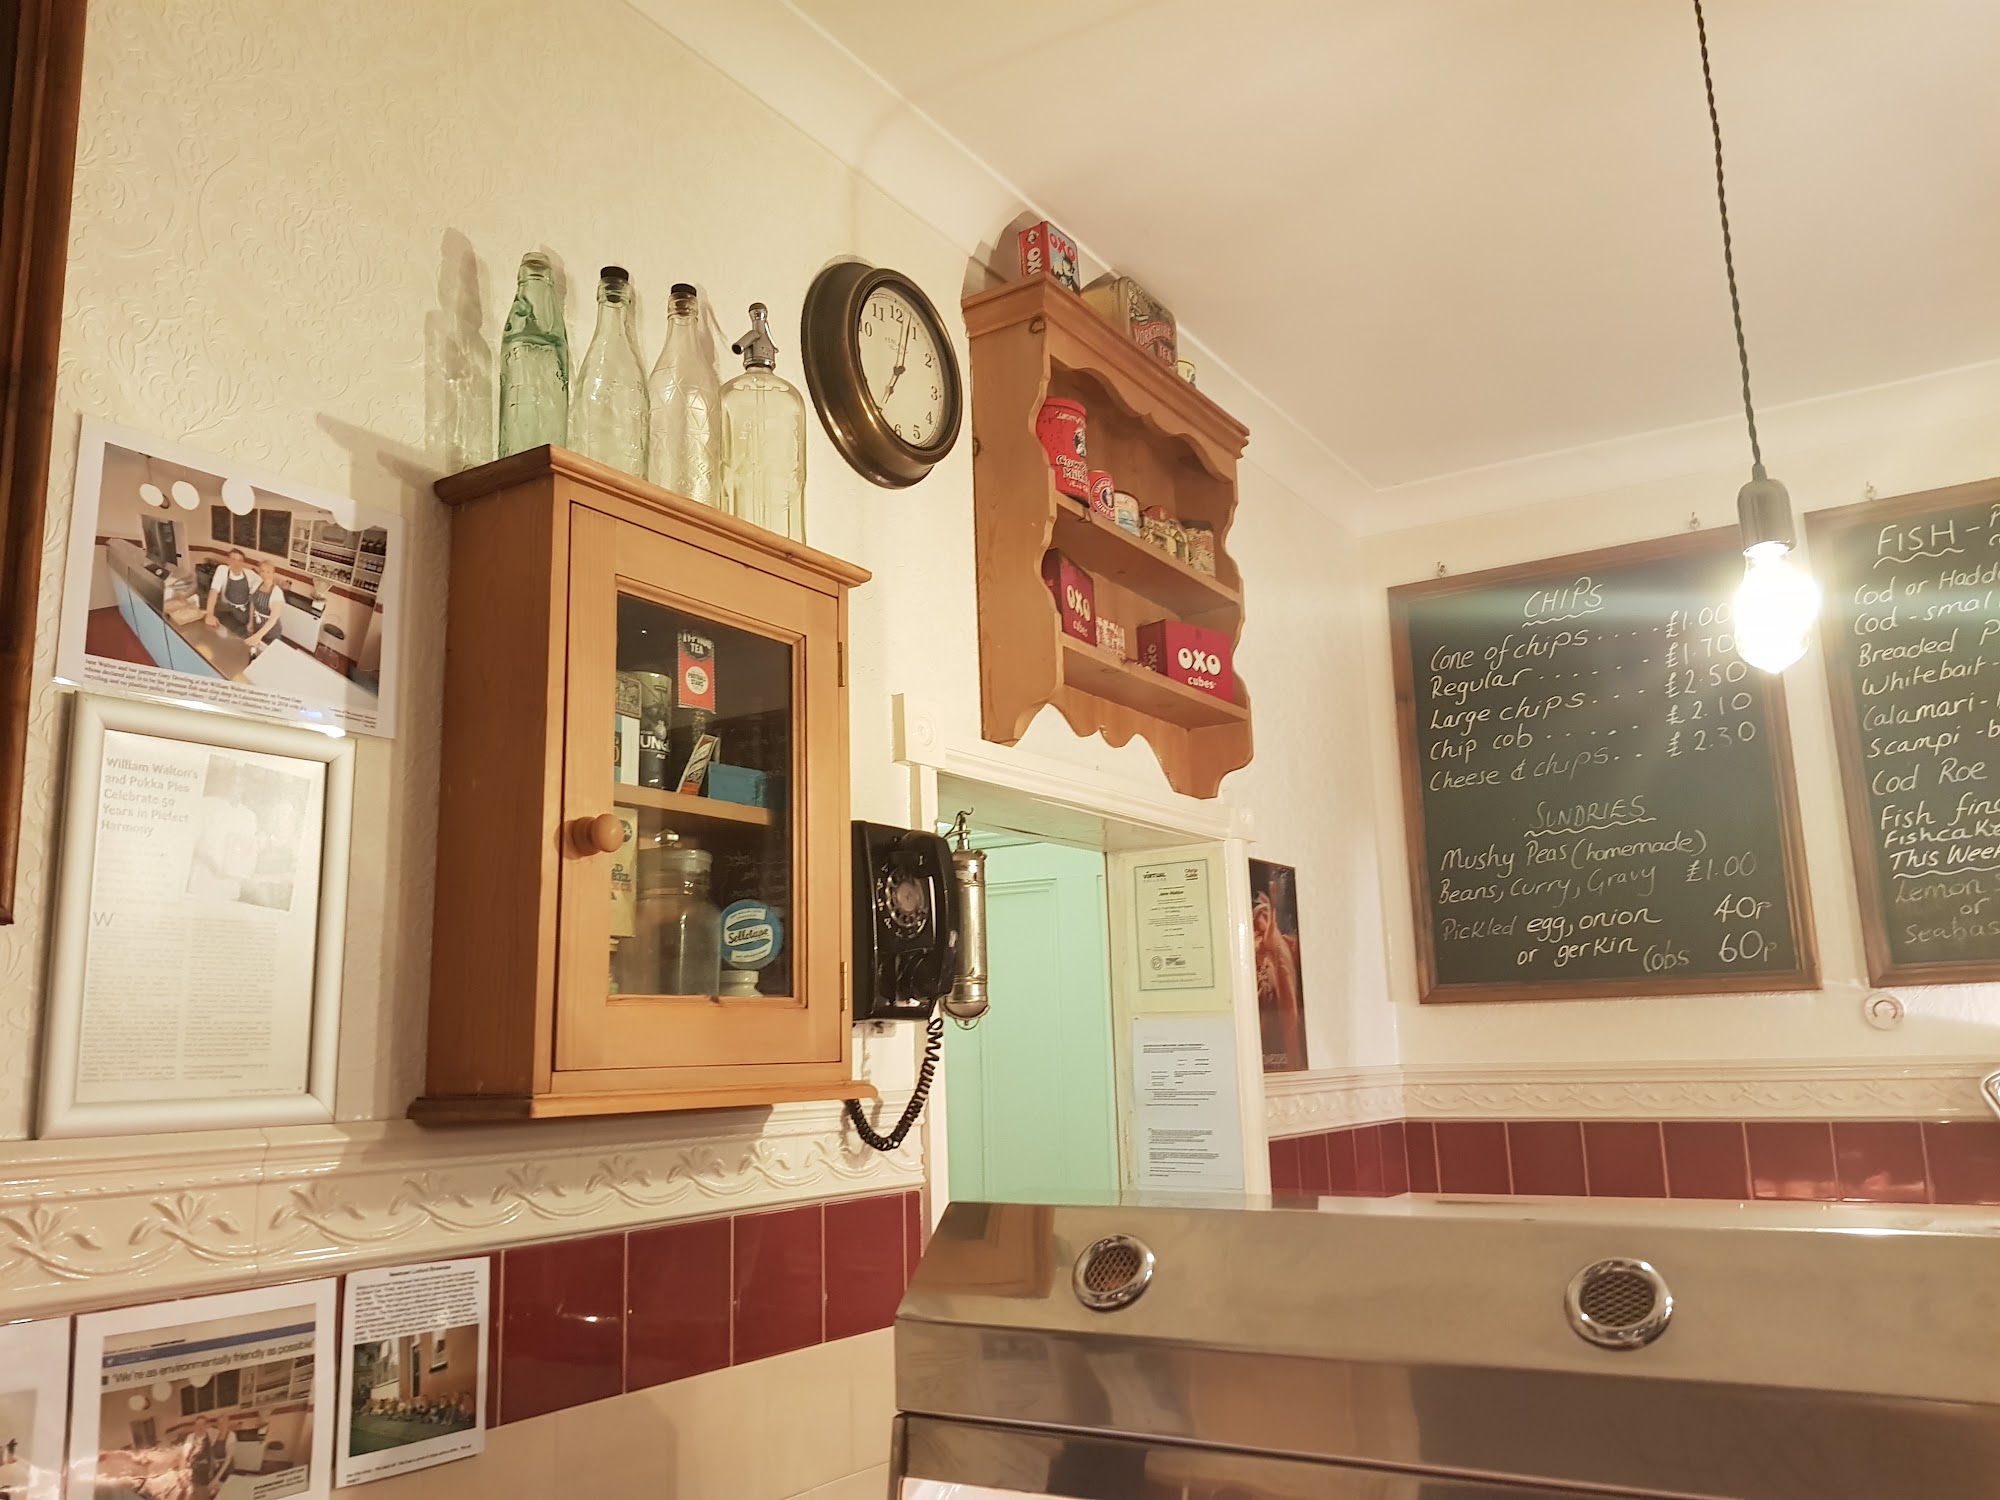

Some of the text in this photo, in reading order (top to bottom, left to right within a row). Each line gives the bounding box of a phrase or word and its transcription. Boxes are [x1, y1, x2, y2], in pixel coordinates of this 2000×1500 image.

[1027, 247, 1042, 275] OX
[1049, 233, 1076, 262] OXO
[889, 305, 903, 324] 12
[924, 353, 932, 368] 2
[930, 386, 938, 401] 3
[913, 424, 921, 440] 5
[925, 411, 933, 425] 4
[1877, 520, 1956, 556] FISH
[1066, 584, 1092, 622] OXO
[1523, 576, 1604, 619] CHIPS
[1855, 576, 1897, 604] Cod
[1905, 580, 1930, 596] or
[1854, 590, 2000, 635] Cod smal
[690, 643, 704, 655] TEA
[1177, 647, 1222, 676] OXO
[1431, 646, 1475, 672] Cone
[1484, 635, 1510, 671] of
[1513, 628, 1589, 661] chips
[1858, 627, 1959, 668] Breaded
[1187, 676, 1217, 689] cubes
[1431, 667, 1533, 705] Regular
[1862, 655, 1987, 696] Whitebait
[1430, 661, 1748, 737] Large chips £2.50
[1863, 692, 1975, 730] Calamari
[1430, 693, 1753, 763] Chip cob £2.10
[1867, 726, 1961, 759] Scampi
[105, 774, 127, 785] and
[129, 776, 164, 790] Pukka
[106, 757, 198, 780] William Walton's
[1430, 767, 1501, 792] Cheese
[1533, 746, 1609, 780] chips
[1872, 757, 1988, 796] Cod Roe
[103, 803, 134, 817] Years
[104, 787, 159, 804] Celebrate
[1529, 794, 1647, 830] SUNDRIES
[1881, 800, 1936, 831] Fish
[101, 819, 154, 838] Harmony
[1441, 828, 1708, 879] Mushy Peas (homemade)
[1890, 848, 1939, 871] This
[1438, 879, 1505, 904] Beans,
[1586, 865, 1656, 896] Gravy
[1895, 879, 1986, 903] Lemon
[1960, 898, 1990, 915] or
[728, 929, 769, 944] Sellotape
[1441, 915, 1516, 941] Pickled
[1526, 914, 1574, 943] egg,
[1578, 906, 1663, 928] onion
[1516, 947, 1539, 966] or
[1555, 936, 1639, 967] gerkin
